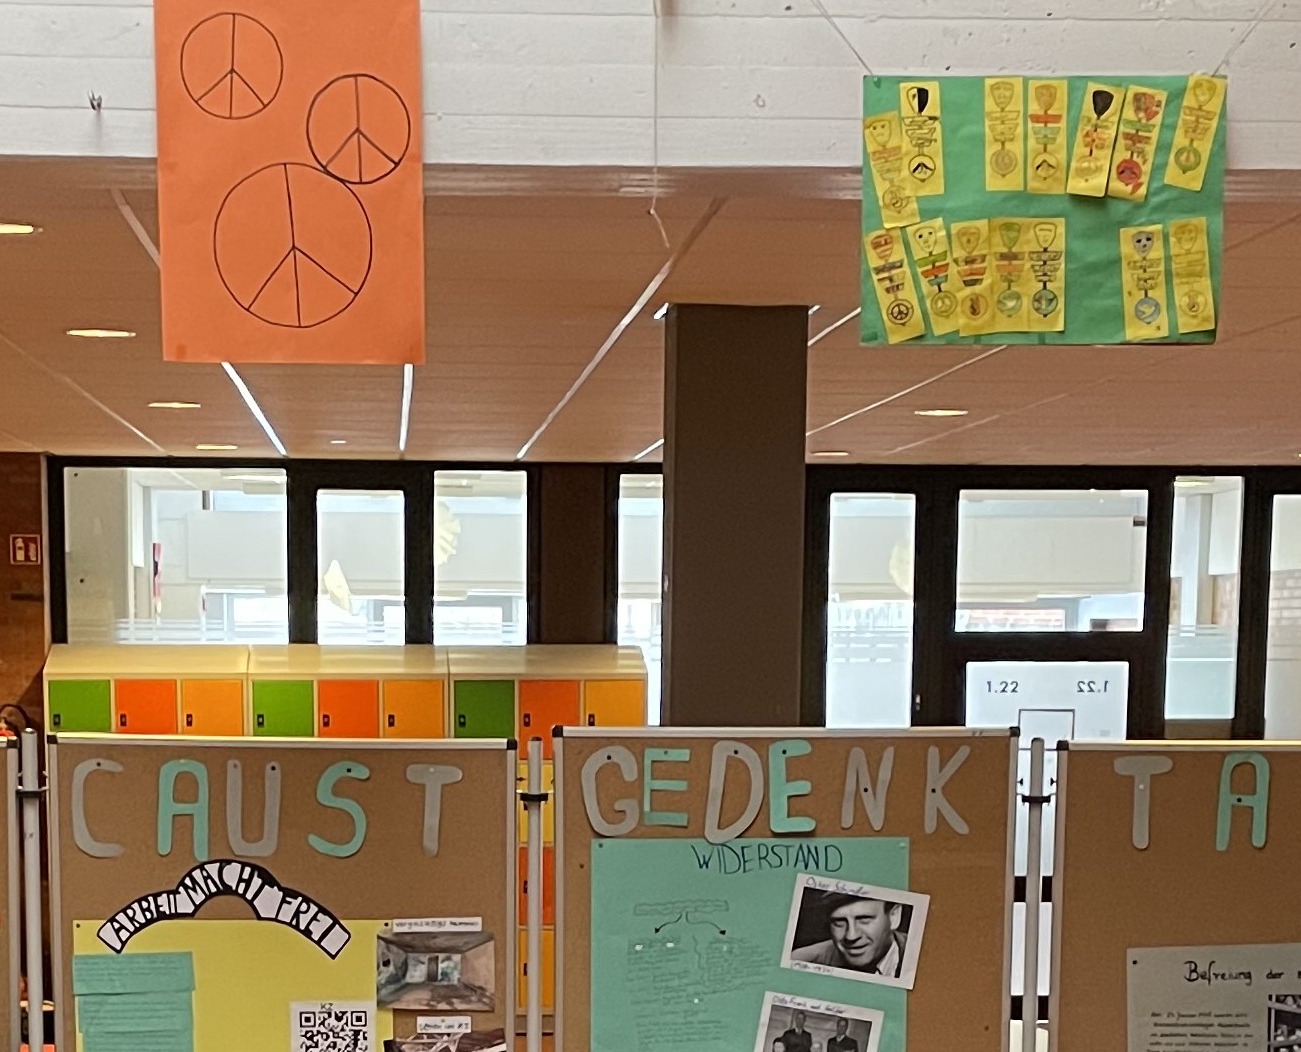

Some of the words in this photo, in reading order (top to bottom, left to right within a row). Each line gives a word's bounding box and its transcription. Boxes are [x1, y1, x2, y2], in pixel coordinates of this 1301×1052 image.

[987, 680, 1019, 694] 1.22
[581, 739, 971, 844] GEDENK
[691, 843, 843, 875] WIDERSTAND
[1183, 960, 1253, 986] Befreiung
[1266, 969, 1285, 979] der
